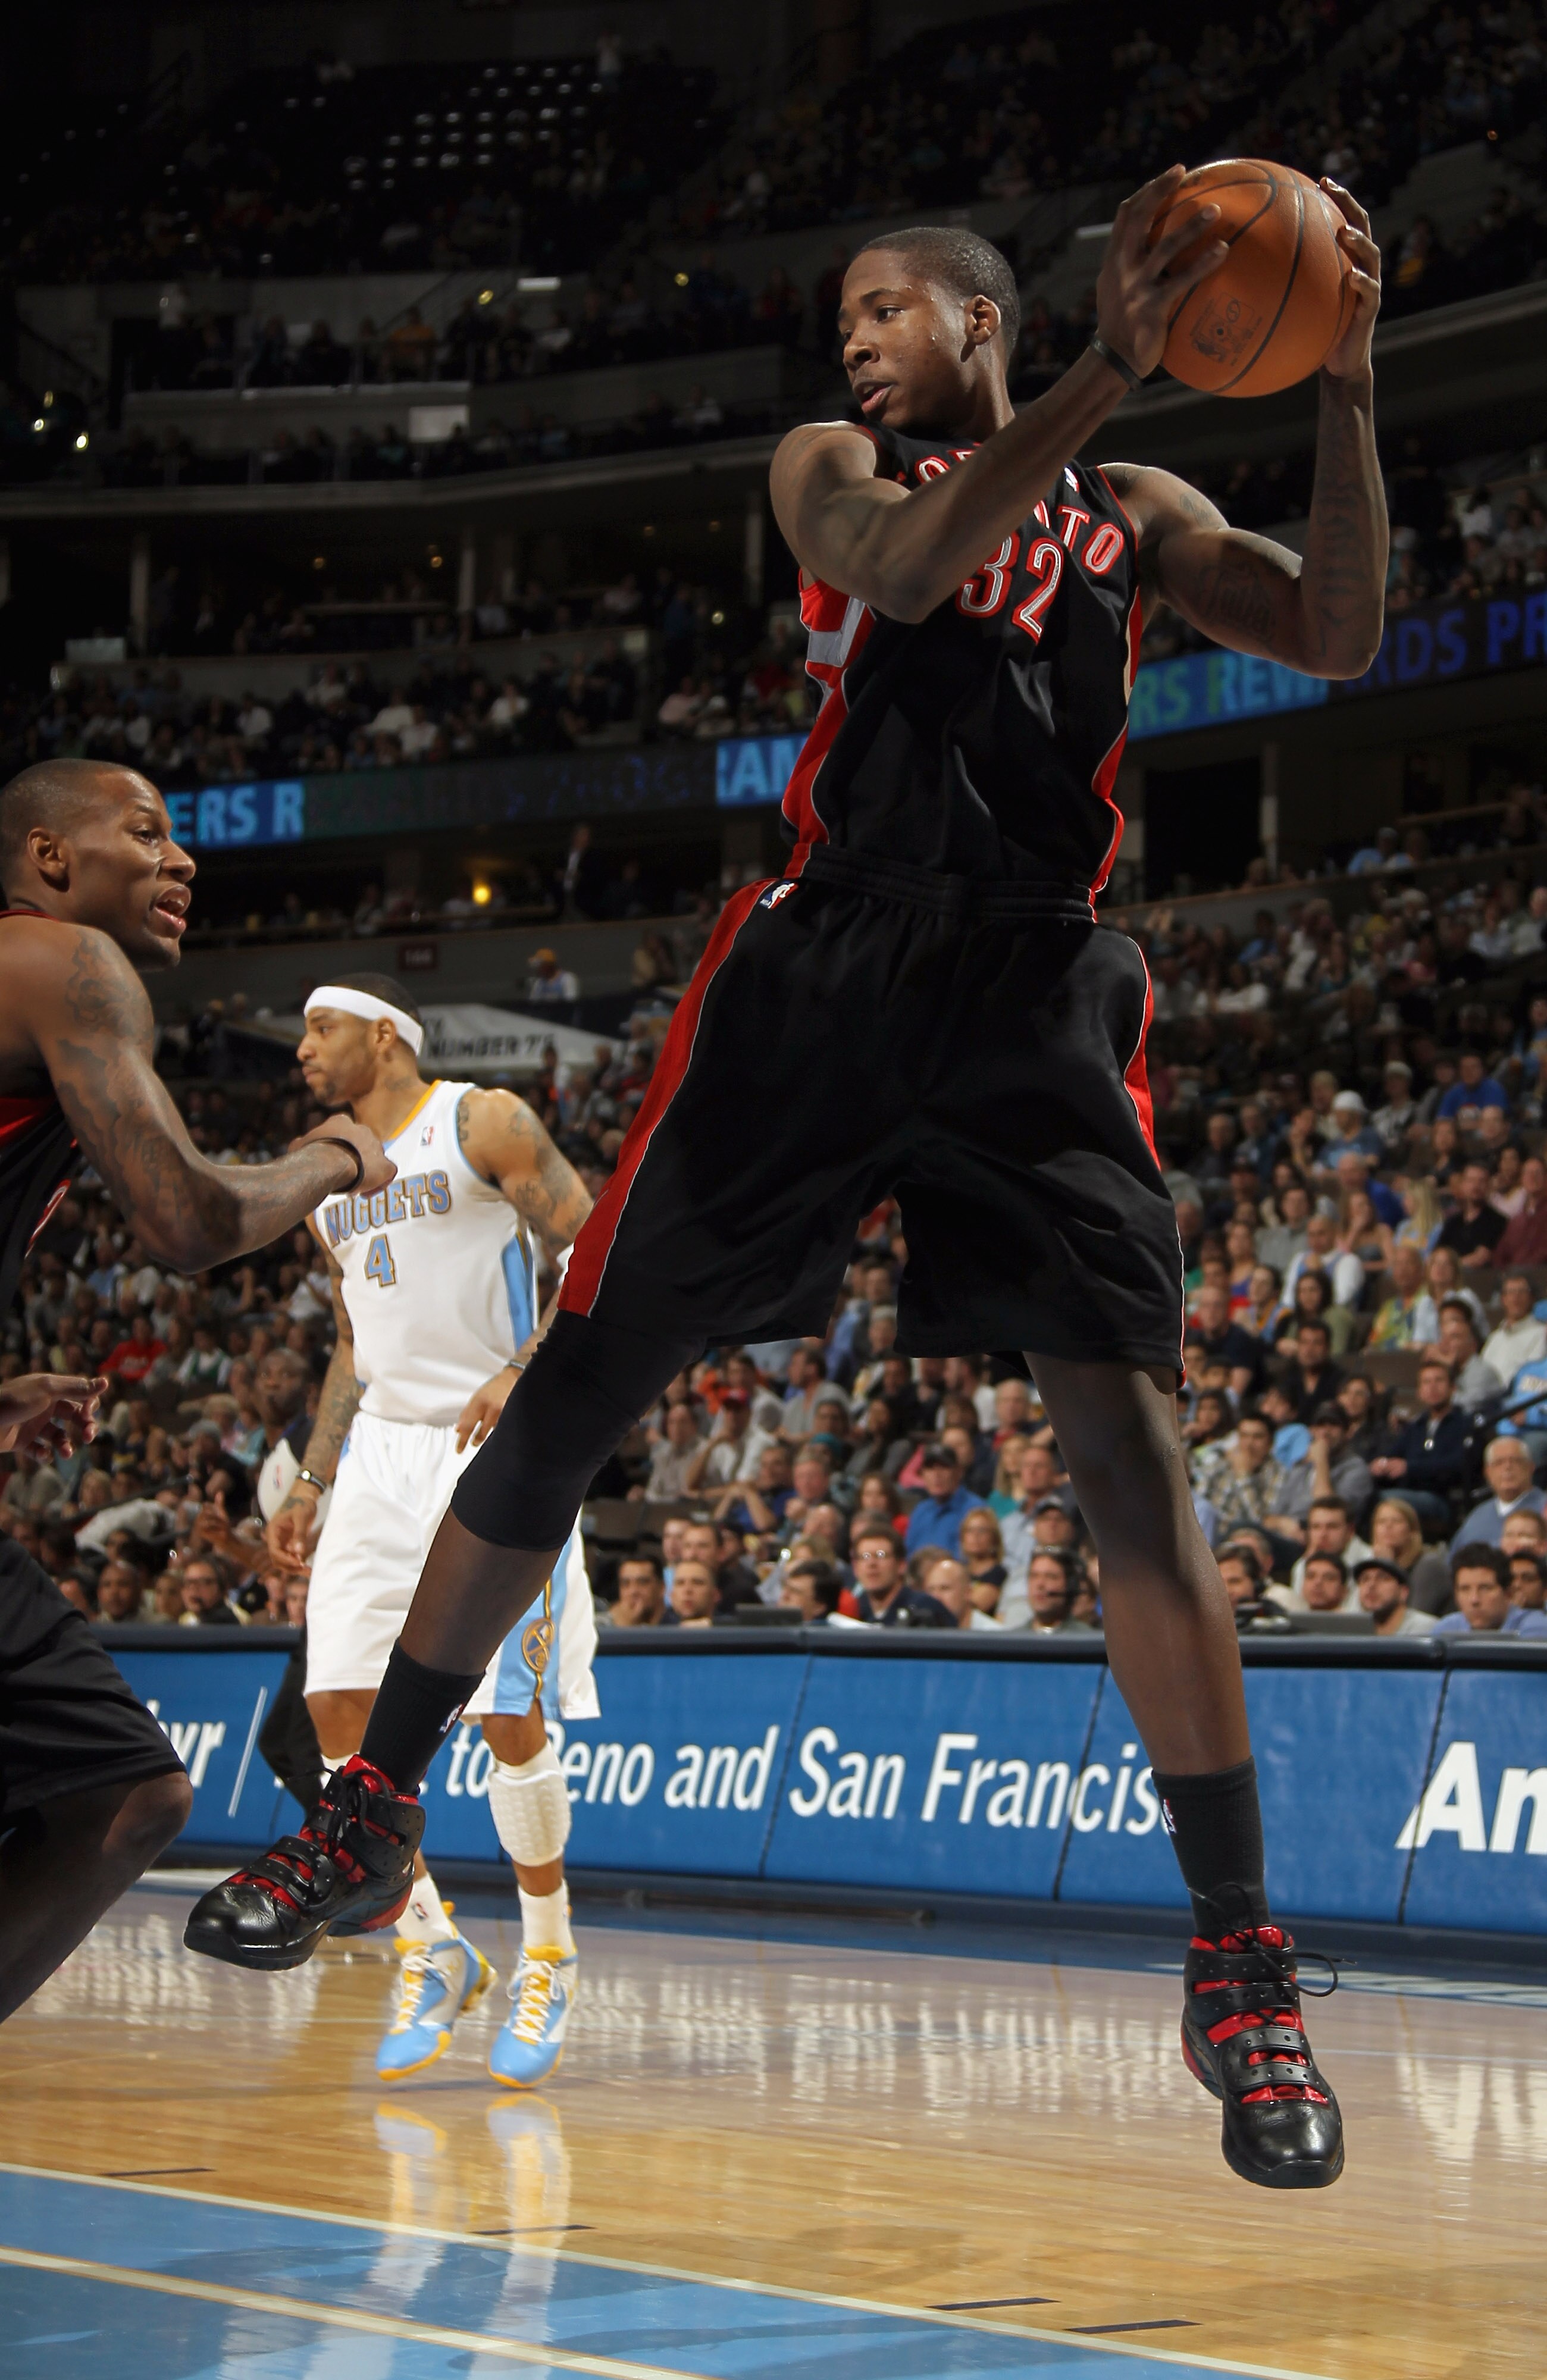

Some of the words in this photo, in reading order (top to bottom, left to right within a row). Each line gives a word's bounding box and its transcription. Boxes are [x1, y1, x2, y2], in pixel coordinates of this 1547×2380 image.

[956, 530, 1064, 646] 32
[323, 1169, 451, 1248] NUGGETS
[364, 1233, 396, 1288] 4
[664, 1724, 780, 1811] and
[788, 1726, 907, 1820] San
[920, 1733, 1172, 1836] Francis
